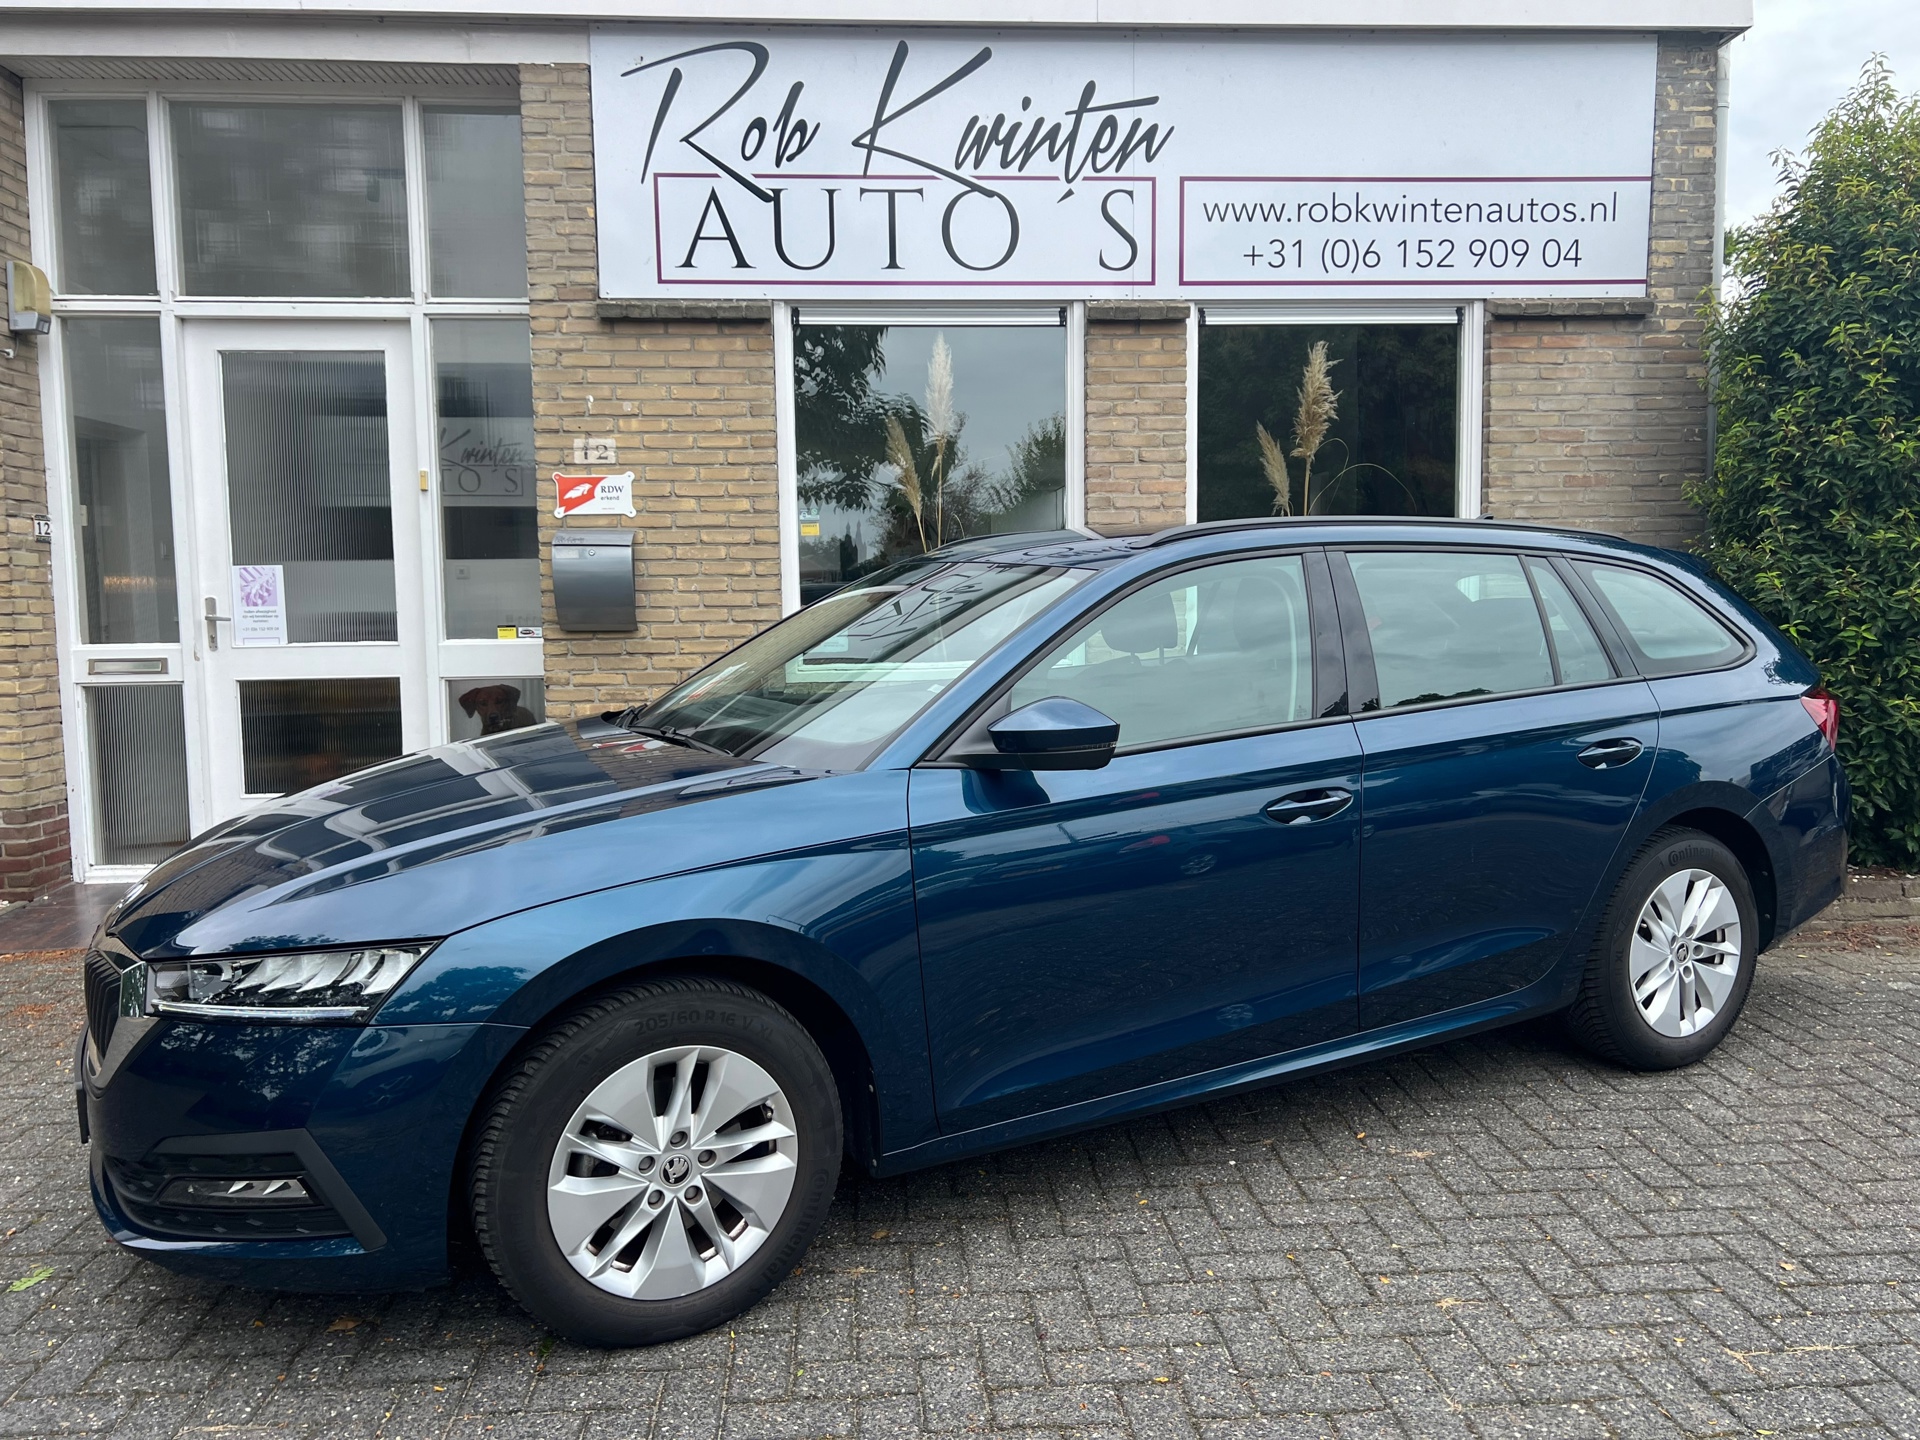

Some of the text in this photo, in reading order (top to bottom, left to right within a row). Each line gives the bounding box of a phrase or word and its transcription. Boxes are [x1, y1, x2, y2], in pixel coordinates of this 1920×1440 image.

[620, 40, 1175, 203] Rob Kwinten
[1202, 191, 1618, 224] www.robkwintenautos.nl
[1243, 238, 1583, 273] +31 (0)6 152 909 04
[583, 444, 609, 460] 12
[600, 485, 625, 494] RDW
[37, 521, 51, 535] 12
[634, 1010, 700, 1036] 205/60
[704, 1010, 715, 1024] R
[720, 1012, 737, 1028] 16
